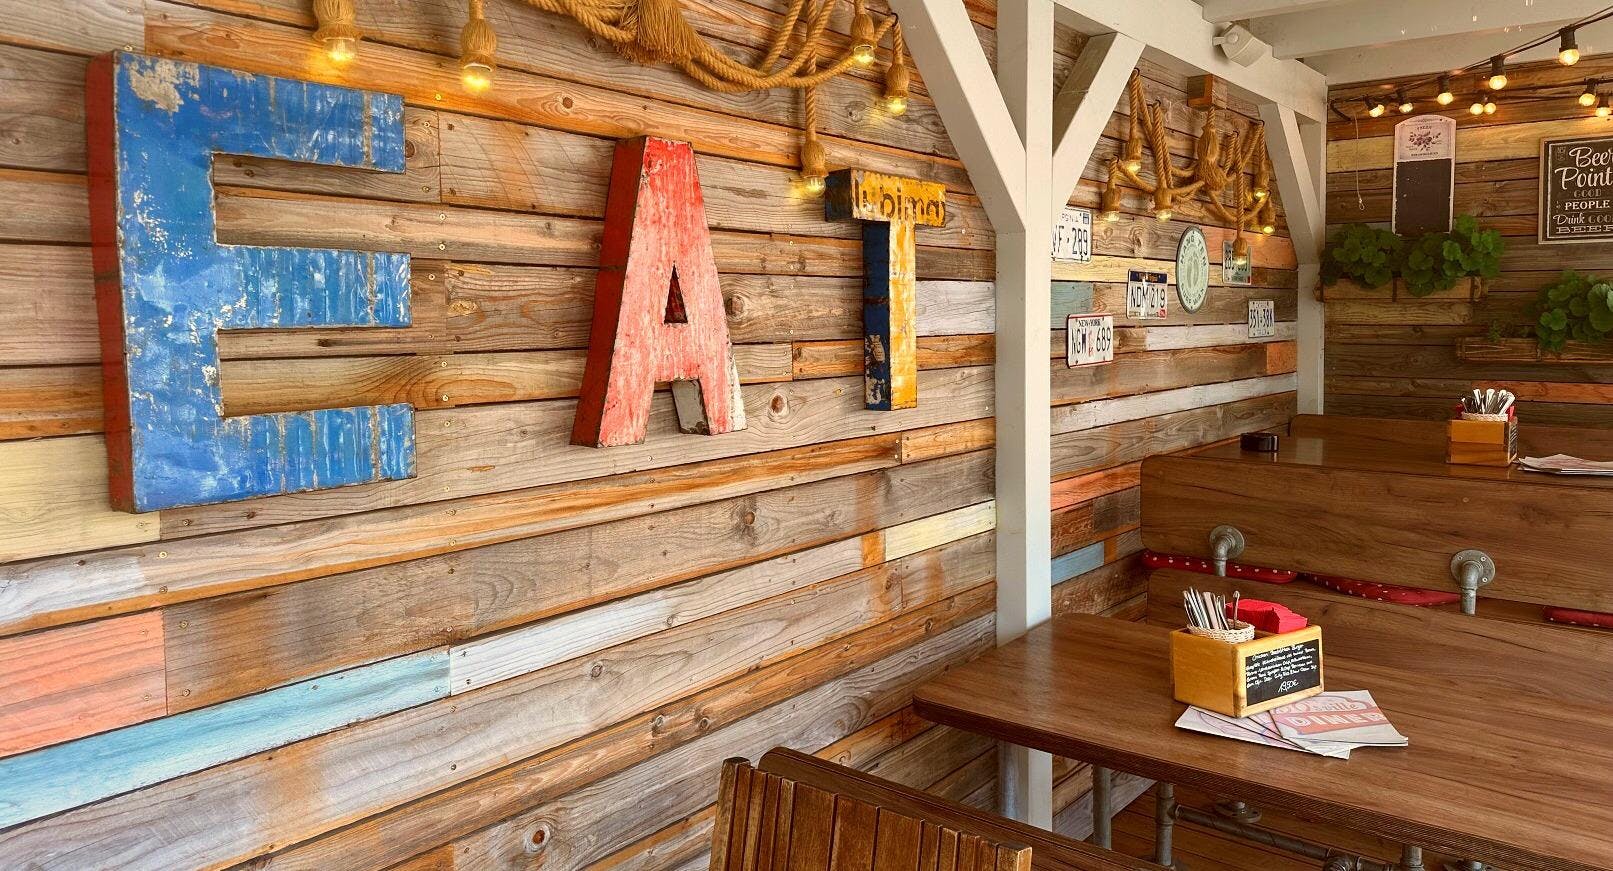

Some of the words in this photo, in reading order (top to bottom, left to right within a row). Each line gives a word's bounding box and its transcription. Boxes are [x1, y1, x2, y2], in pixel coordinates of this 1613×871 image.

[1569, 146, 1613, 167] Beer
[1574, 188, 1602, 198] GOOD
[1565, 200, 1610, 211] PEOPLE
[1553, 213, 1585, 225] Drink
[1588, 214, 1613, 224] GOO
[1095, 327, 1112, 352] 689
[1286, 712, 1383, 727] DINER
